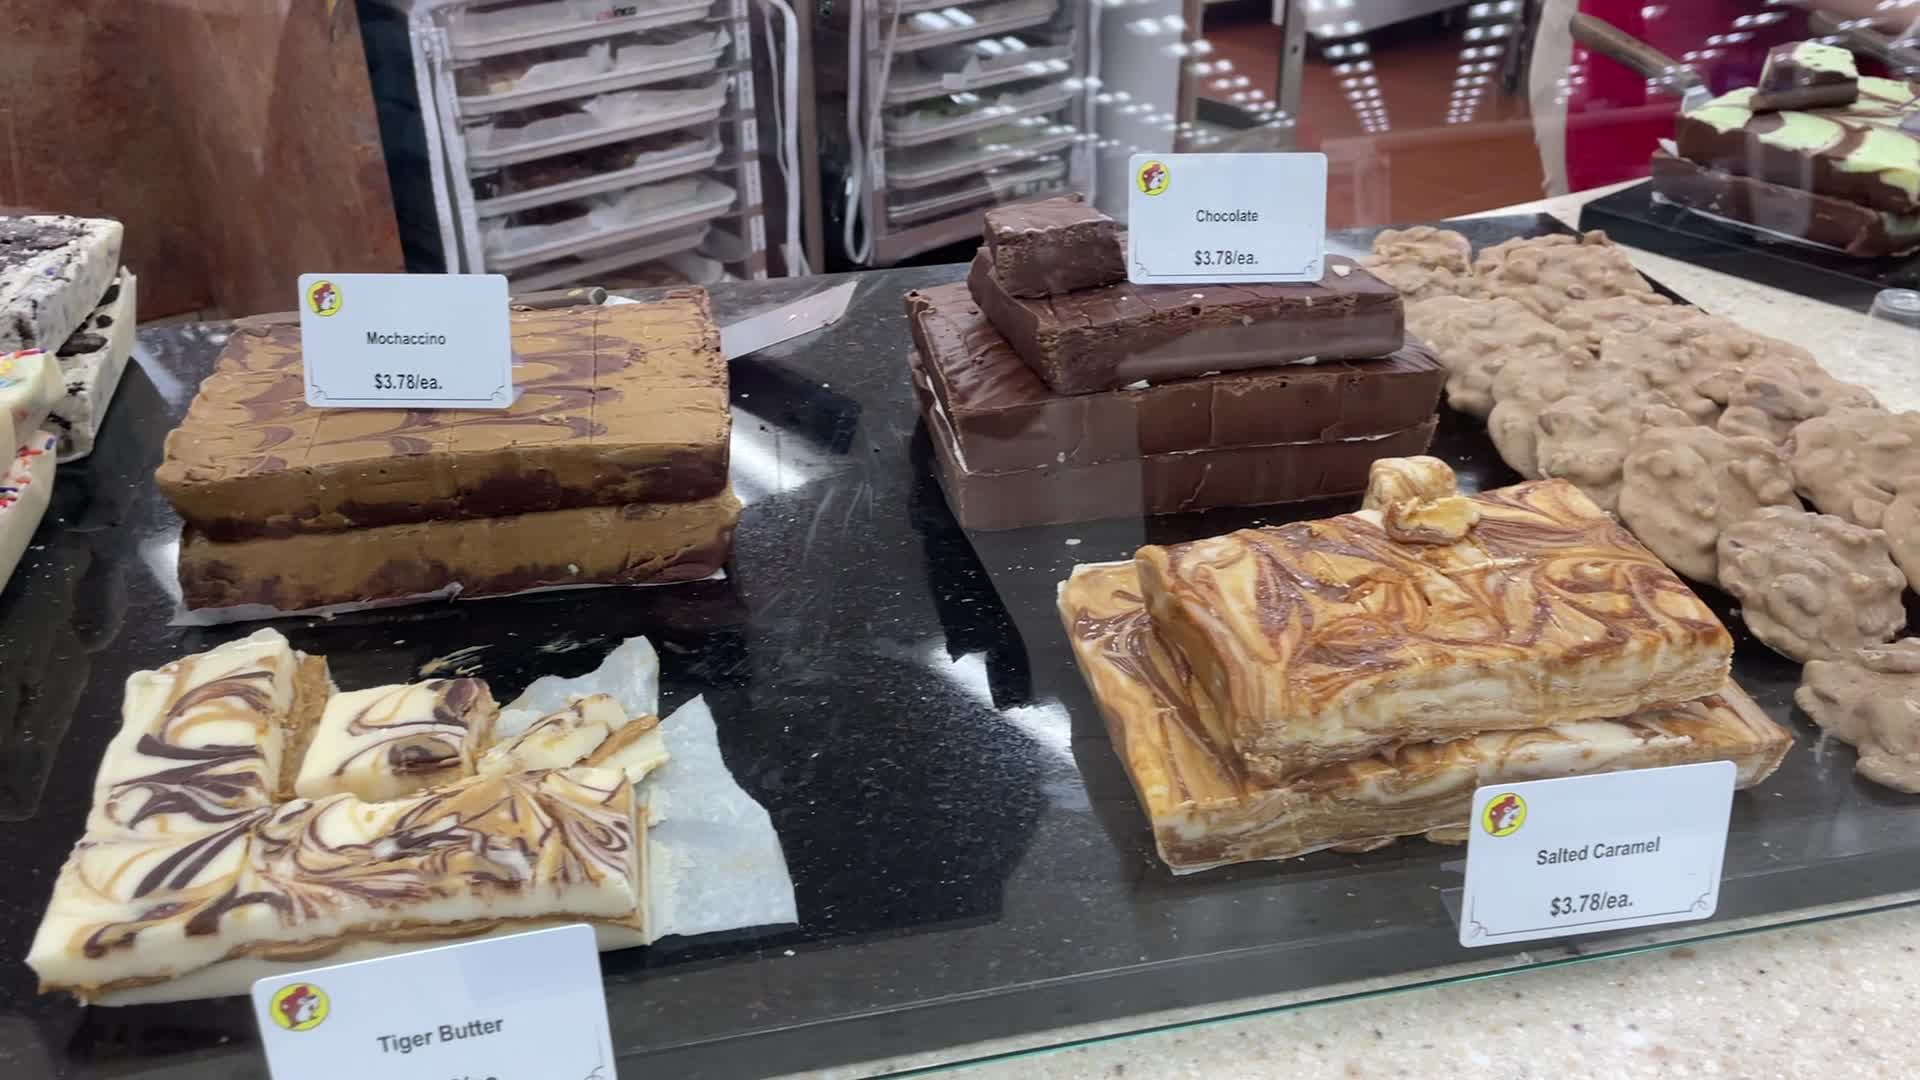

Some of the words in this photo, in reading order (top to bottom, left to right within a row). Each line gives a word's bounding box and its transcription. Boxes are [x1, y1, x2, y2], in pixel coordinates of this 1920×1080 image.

[1195, 208, 1259, 223] Chocolate
[1194, 249, 1259, 267] $3.78/ea.
[365, 331, 447, 346] Mochaccino
[374, 372, 444, 391] $3.78/ea.
[1535, 844, 1590, 866] Salted
[1592, 835, 1662, 860] Caramel
[1549, 891, 1634, 918] $3.78/ea.
[376, 1031, 433, 1055] Tiger
[437, 1018, 504, 1043] Butter
